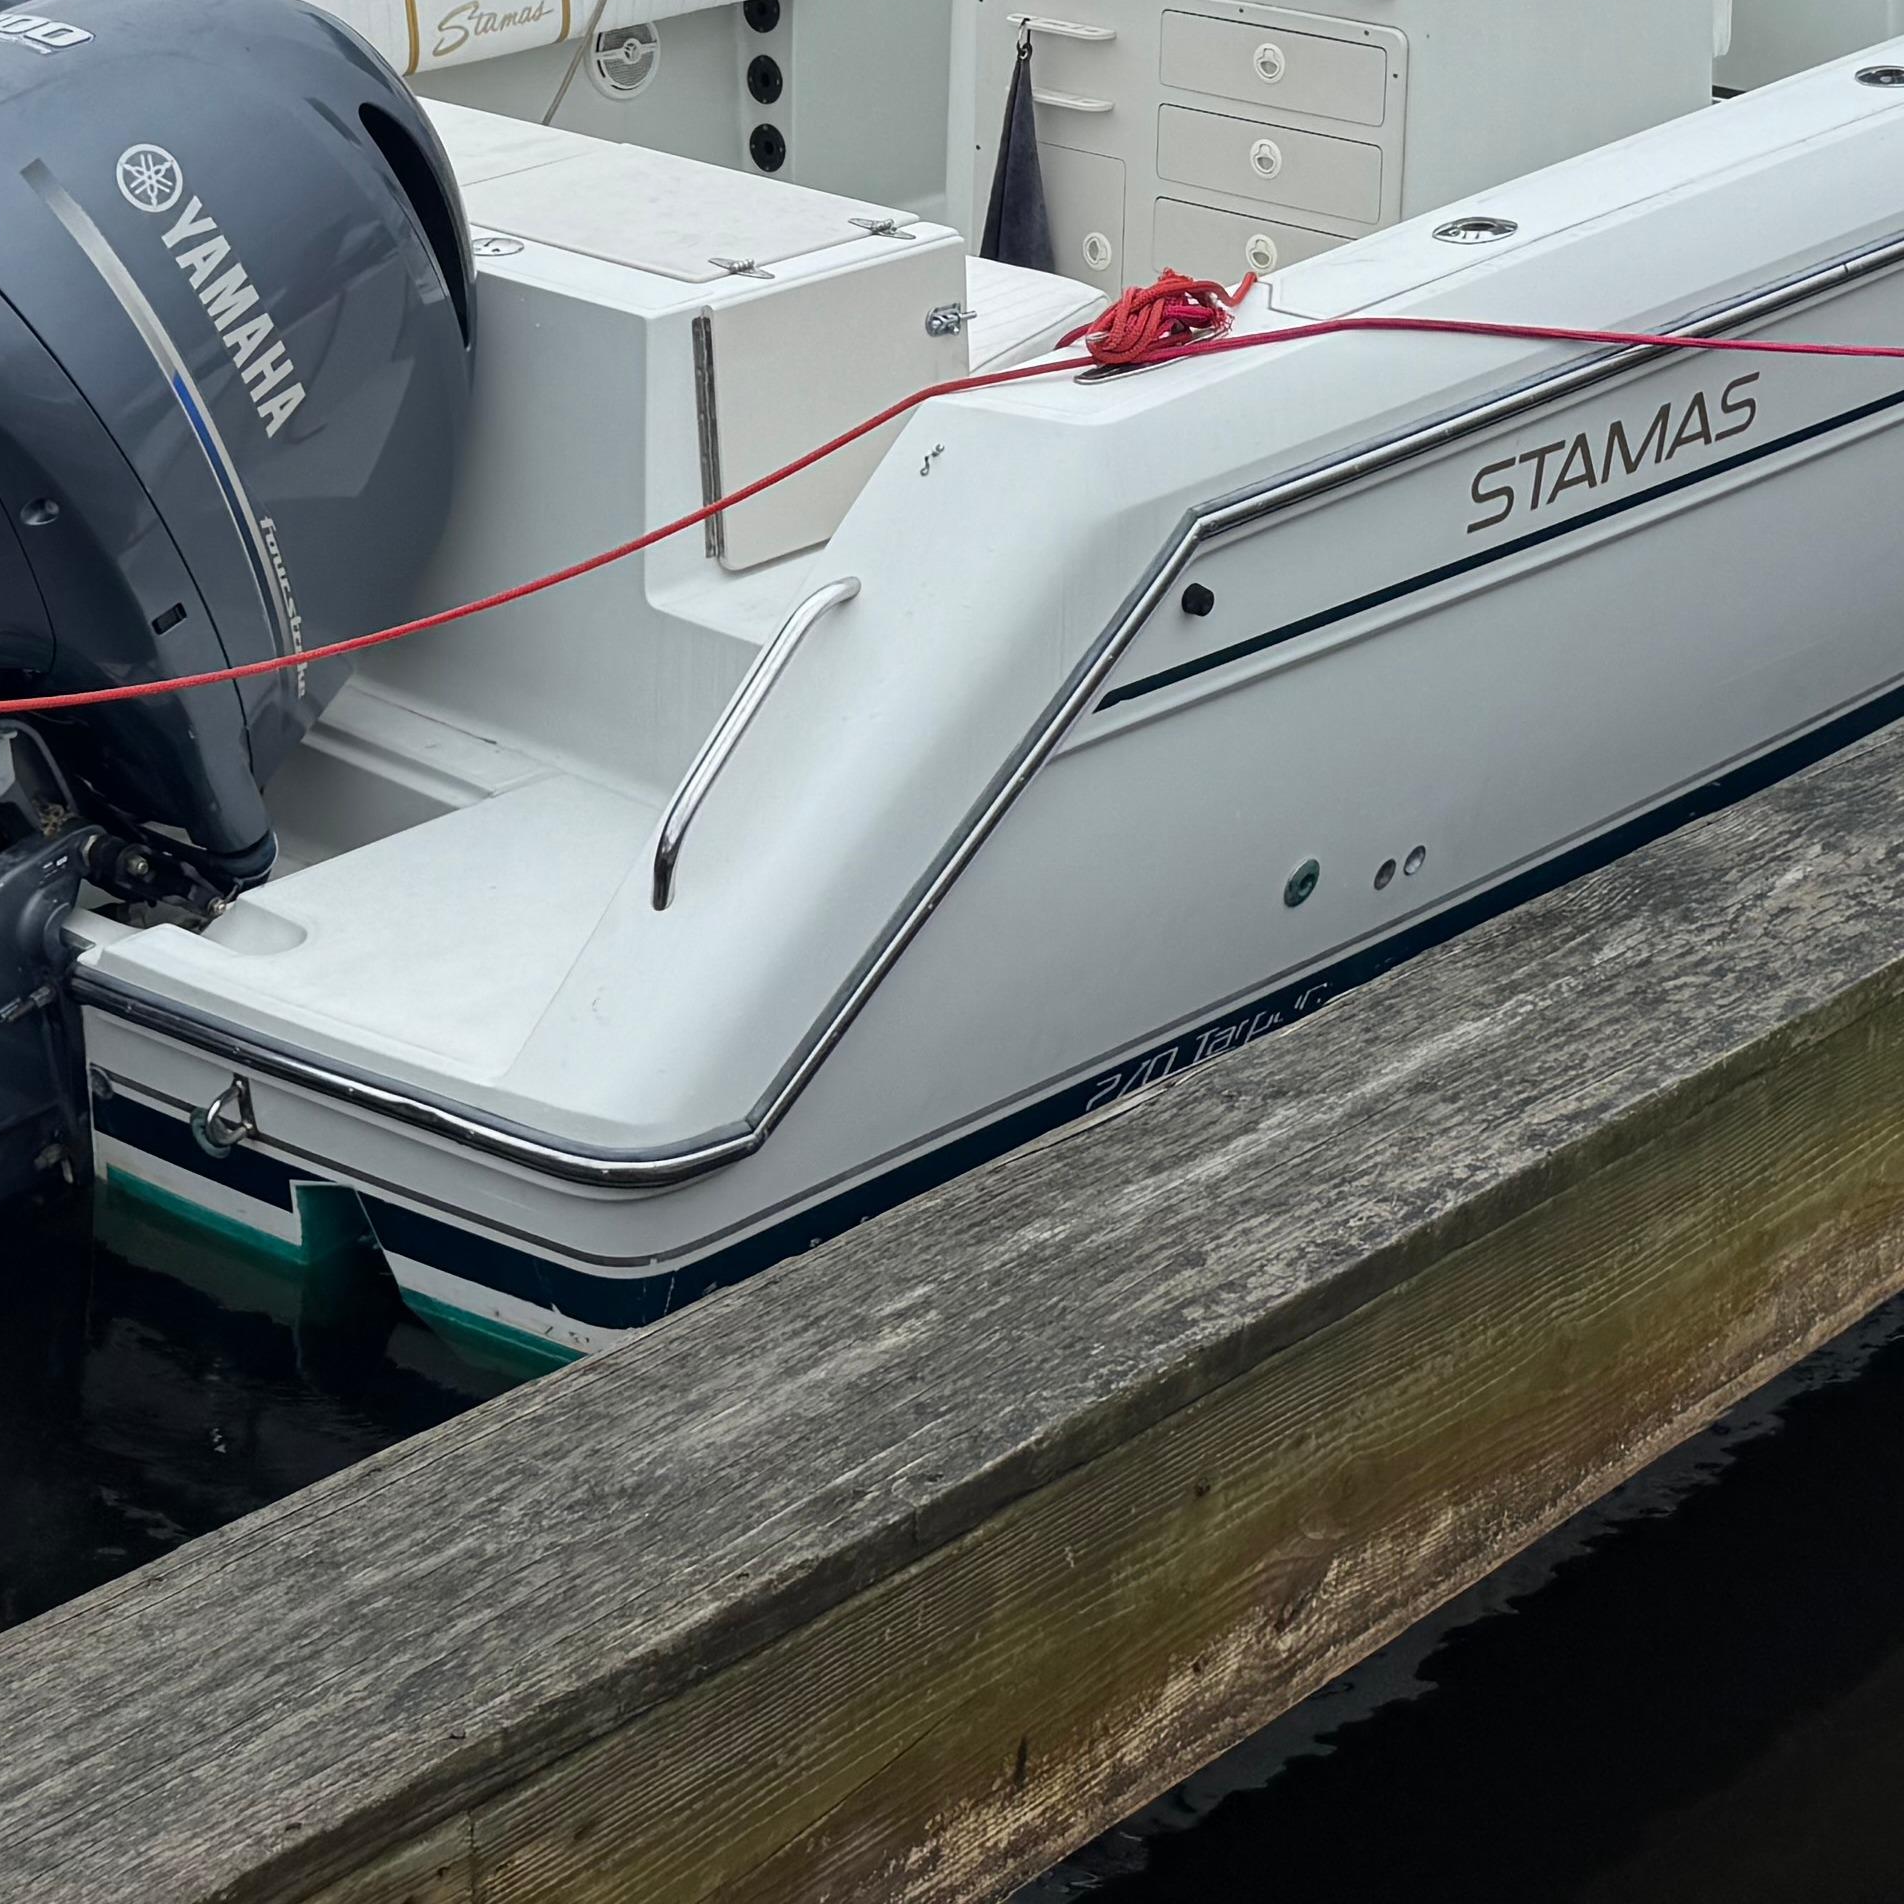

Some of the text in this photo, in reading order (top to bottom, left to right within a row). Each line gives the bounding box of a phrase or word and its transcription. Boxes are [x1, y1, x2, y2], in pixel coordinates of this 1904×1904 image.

[432, 0, 555, 57] Stamas
[160, 194, 306, 440] YAMAHA
[1465, 370, 1761, 535] STAMAS
